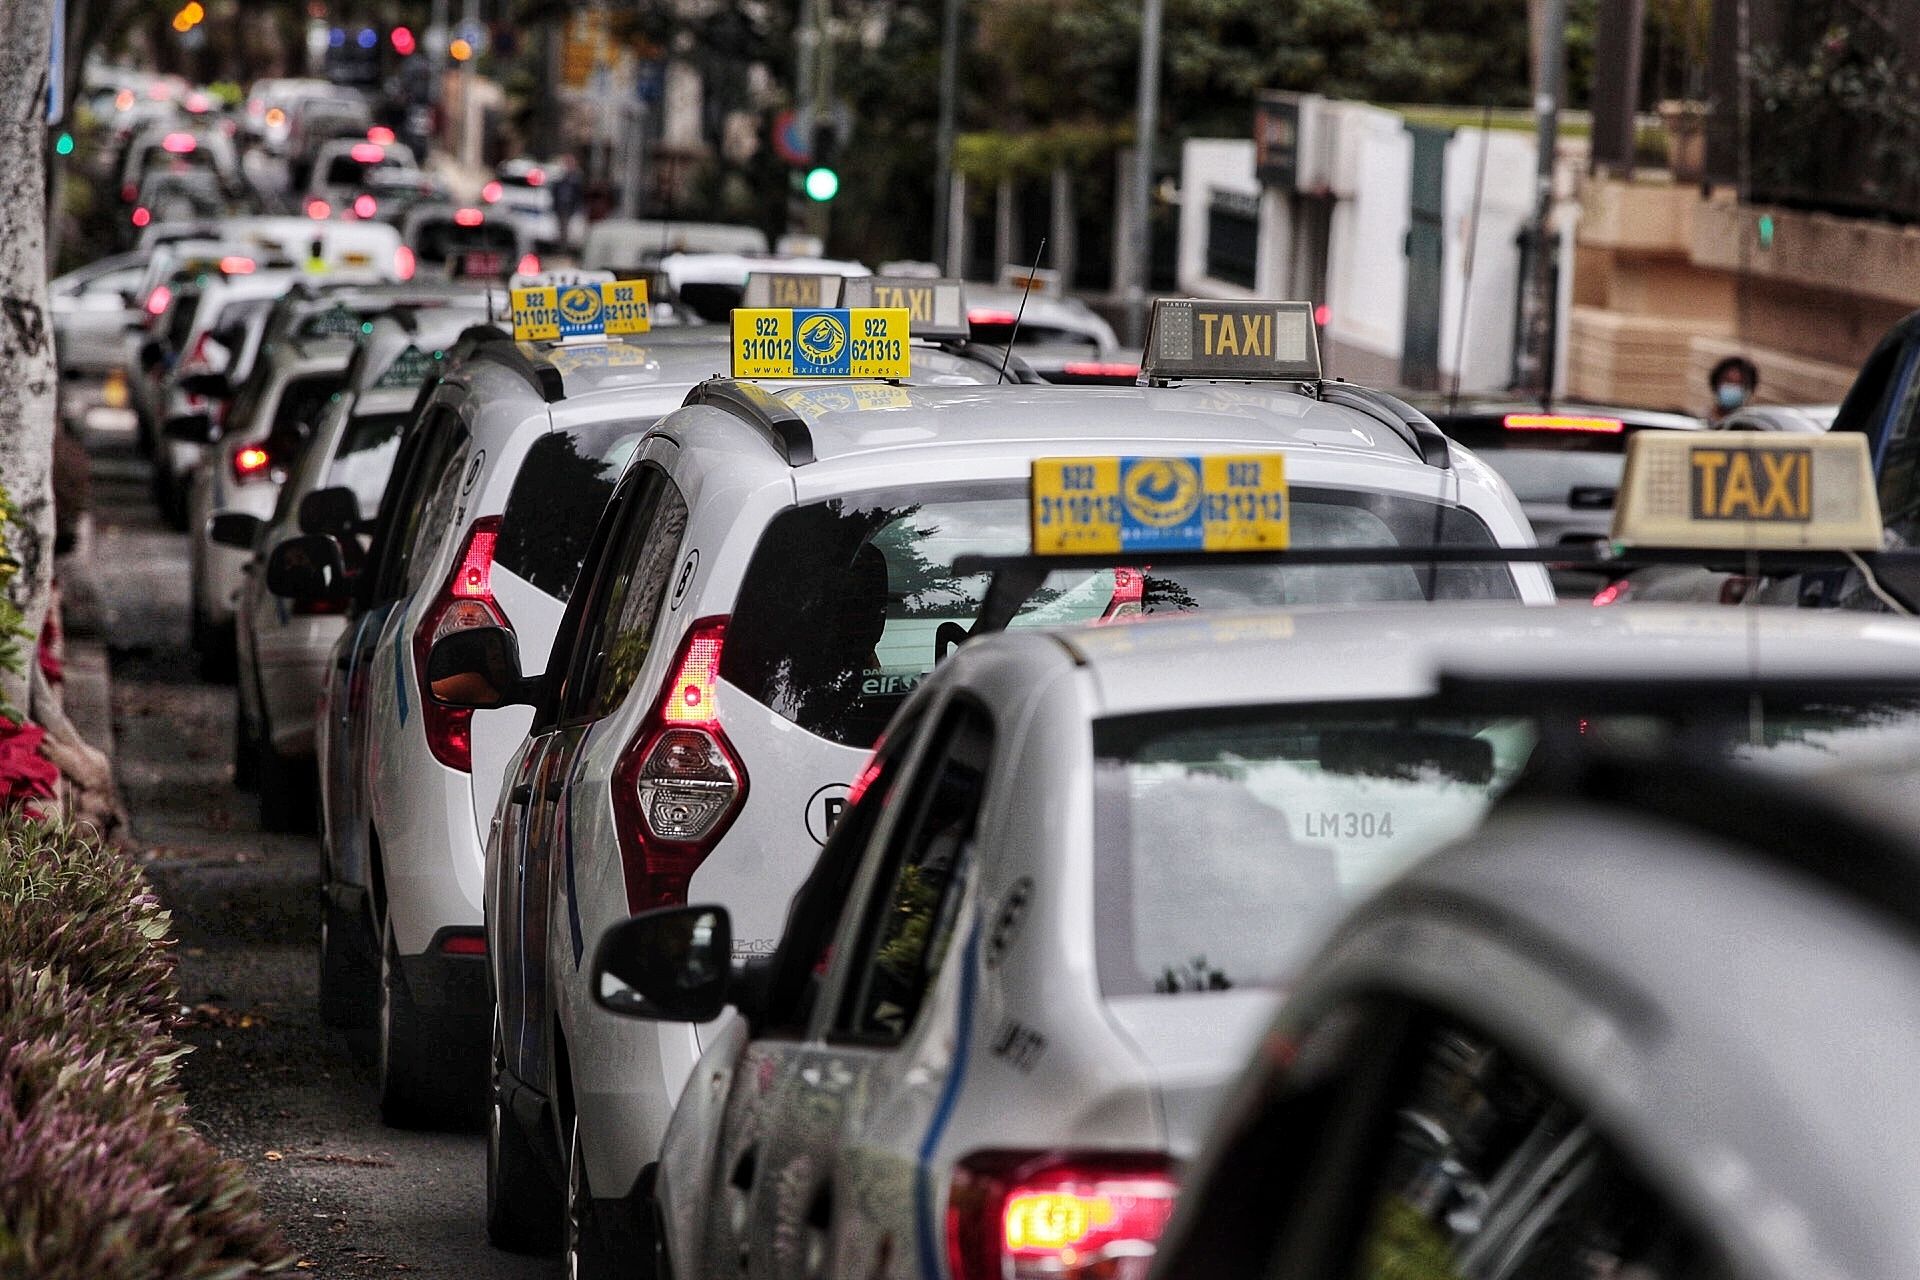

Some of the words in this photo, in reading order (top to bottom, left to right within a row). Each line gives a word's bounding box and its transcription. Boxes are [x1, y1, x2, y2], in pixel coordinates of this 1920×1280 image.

[526, 293, 544, 307] 922
[615, 287, 633, 302] 922
[773, 276, 820, 307] TAXI
[605, 303, 647, 320] 621313
[874, 286, 932, 323] TAXI
[516, 309, 558, 326] 311012
[756, 318, 778, 336] 922
[865, 318, 887, 337] 922
[1199, 313, 1271, 356] TAXI
[743, 339, 792, 360] 311012
[852, 339, 901, 361] 621313
[753, 365, 890, 375] www.taxitenerife.es
[1693, 450, 1809, 517] TAXI
[675, 561, 693, 598] B
[862, 676, 899, 694] elf
[1304, 811, 1395, 839] LM304
